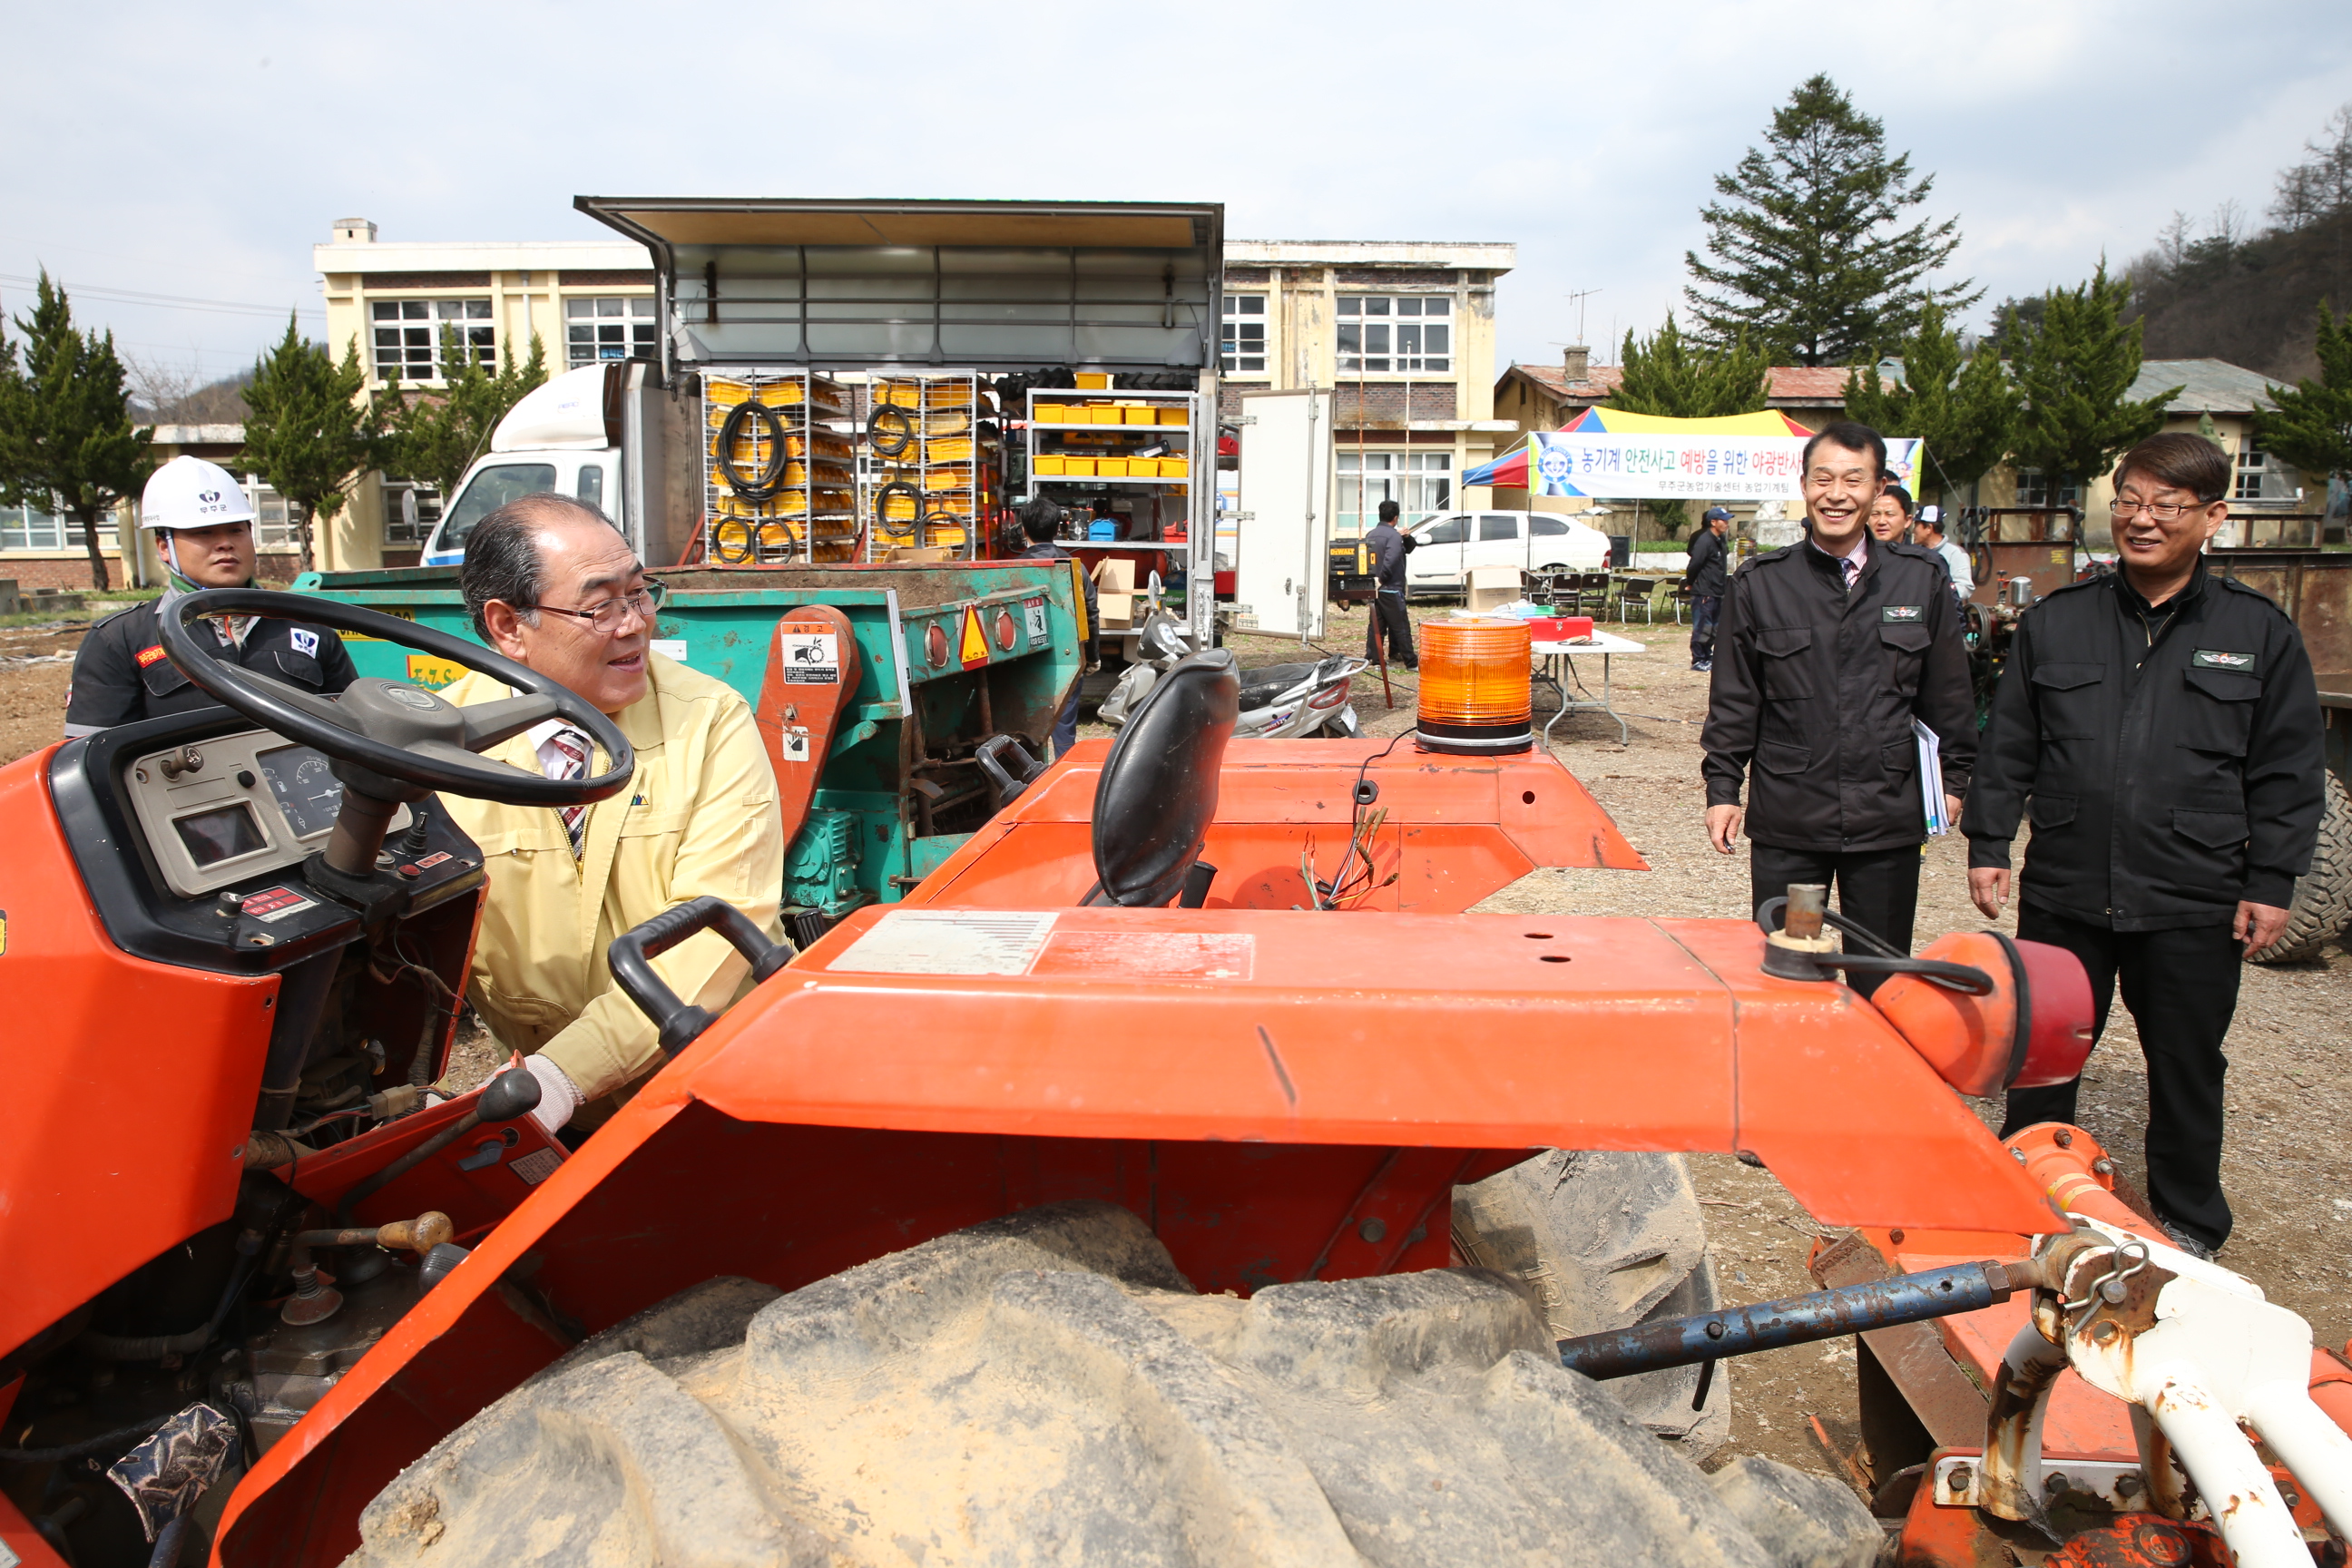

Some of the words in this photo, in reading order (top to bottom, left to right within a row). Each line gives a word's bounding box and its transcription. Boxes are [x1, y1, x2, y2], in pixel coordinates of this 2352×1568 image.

[1582, 447, 1621, 473] 농기계
[1625, 448, 1676, 474] 안전사고
[1680, 449, 1719, 475] 예방을
[1723, 449, 1748, 475] 위한
[1658, 480, 1740, 493] 무주군농업기술센터
[1744, 482, 1789, 494] 농업기계팀
[200, 504, 228, 514] 무주군
